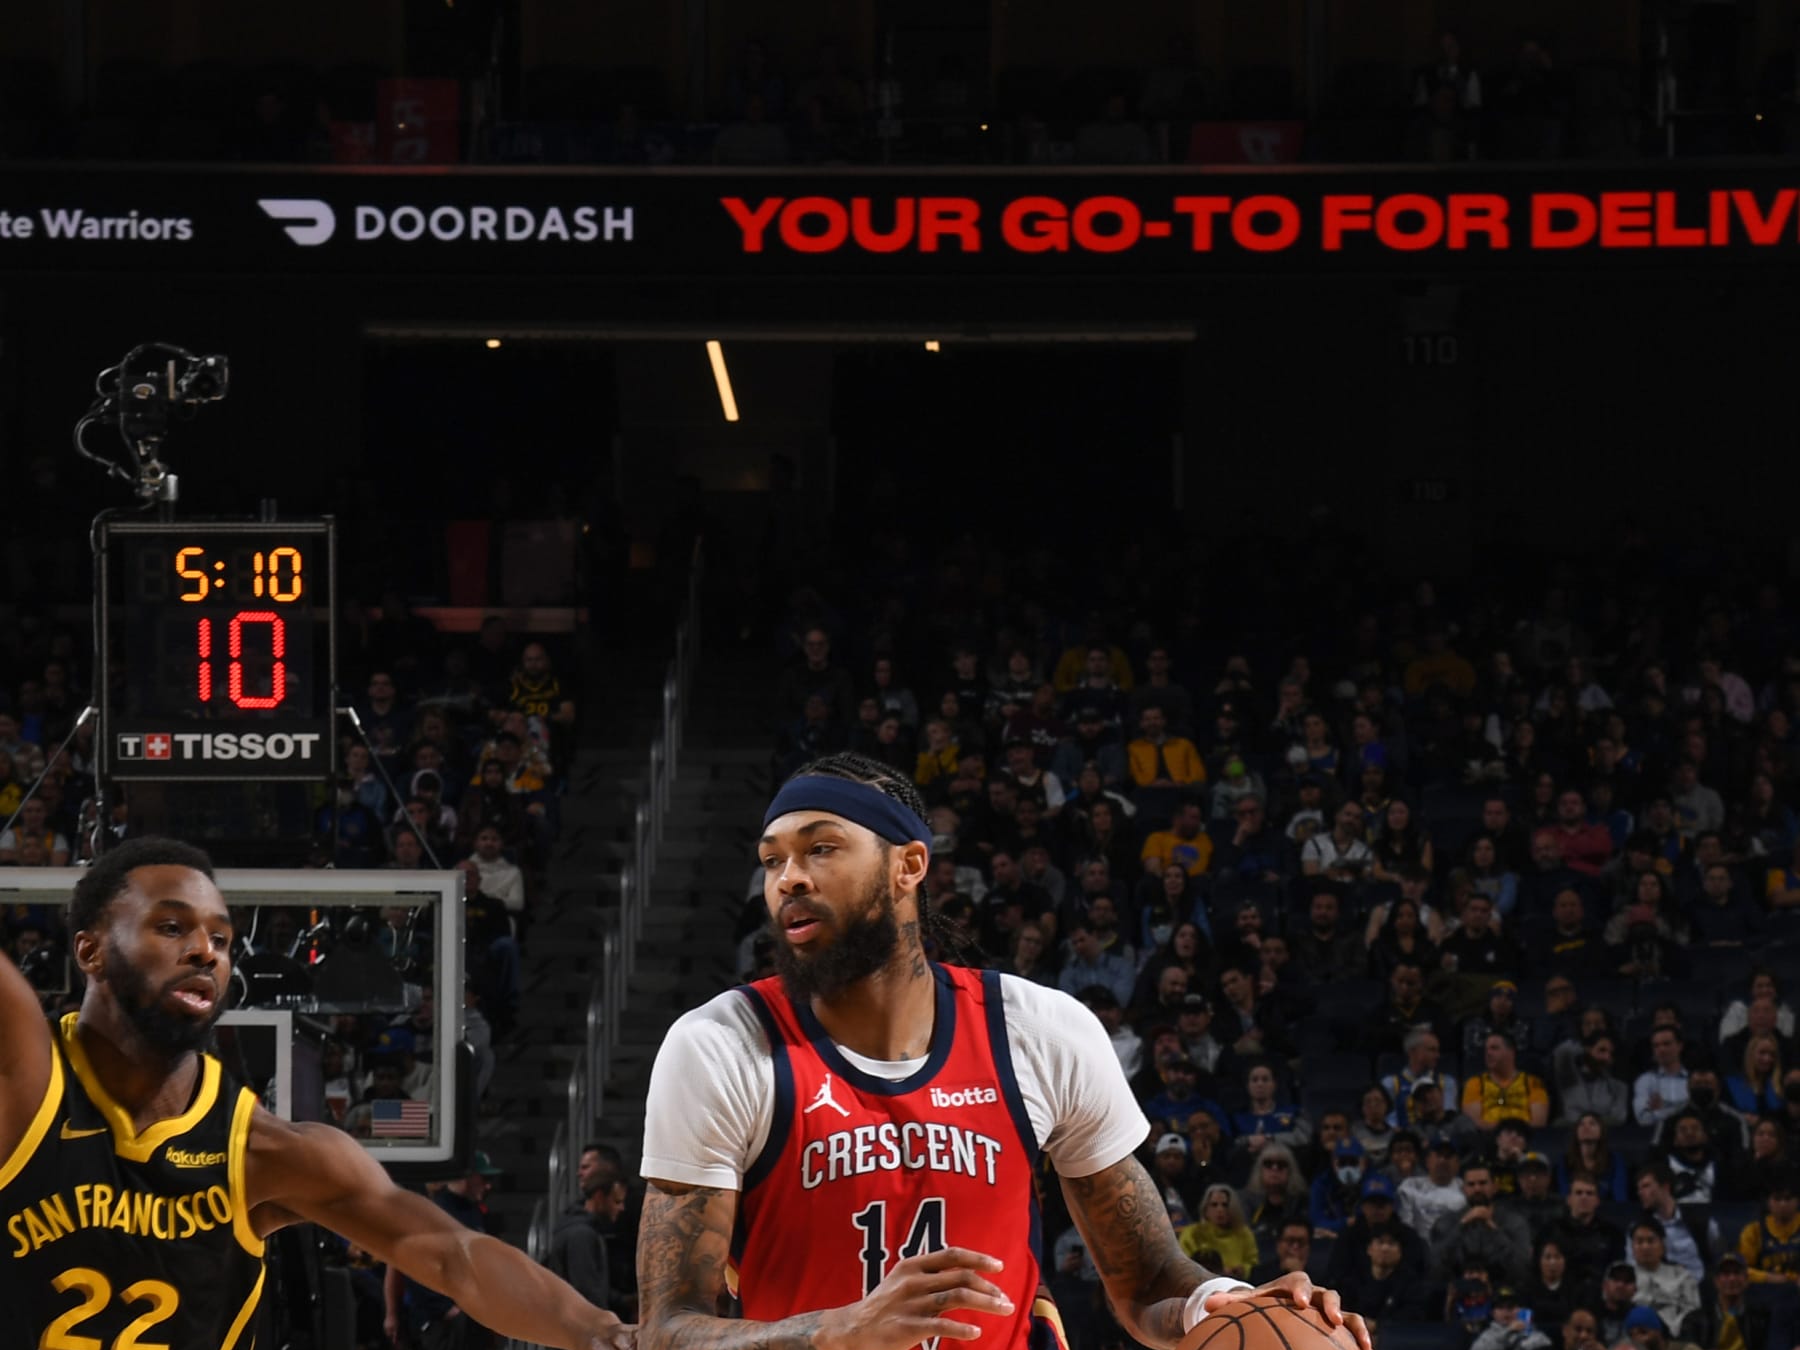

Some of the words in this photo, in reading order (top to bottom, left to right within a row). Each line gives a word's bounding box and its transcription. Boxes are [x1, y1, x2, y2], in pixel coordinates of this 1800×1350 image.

[41, 208, 193, 241] Warriors
[355, 205, 635, 241] DOORDASH
[722, 196, 981, 253] YOUR
[1001, 195, 1300, 253] GO-TO
[1322, 193, 1509, 250] FOR
[1531, 189, 1800, 248] DELIV
[175, 546, 302, 602] 5:10
[197, 611, 286, 709] 10
[173, 733, 320, 760] TISSOT
[929, 1086, 997, 1108] ibotta
[801, 1120, 1002, 1189] CRESCENT
[7, 1192, 76, 1259] SAN
[74, 1184, 233, 1240] FRANCISCO
[852, 1196, 949, 1302] 14
